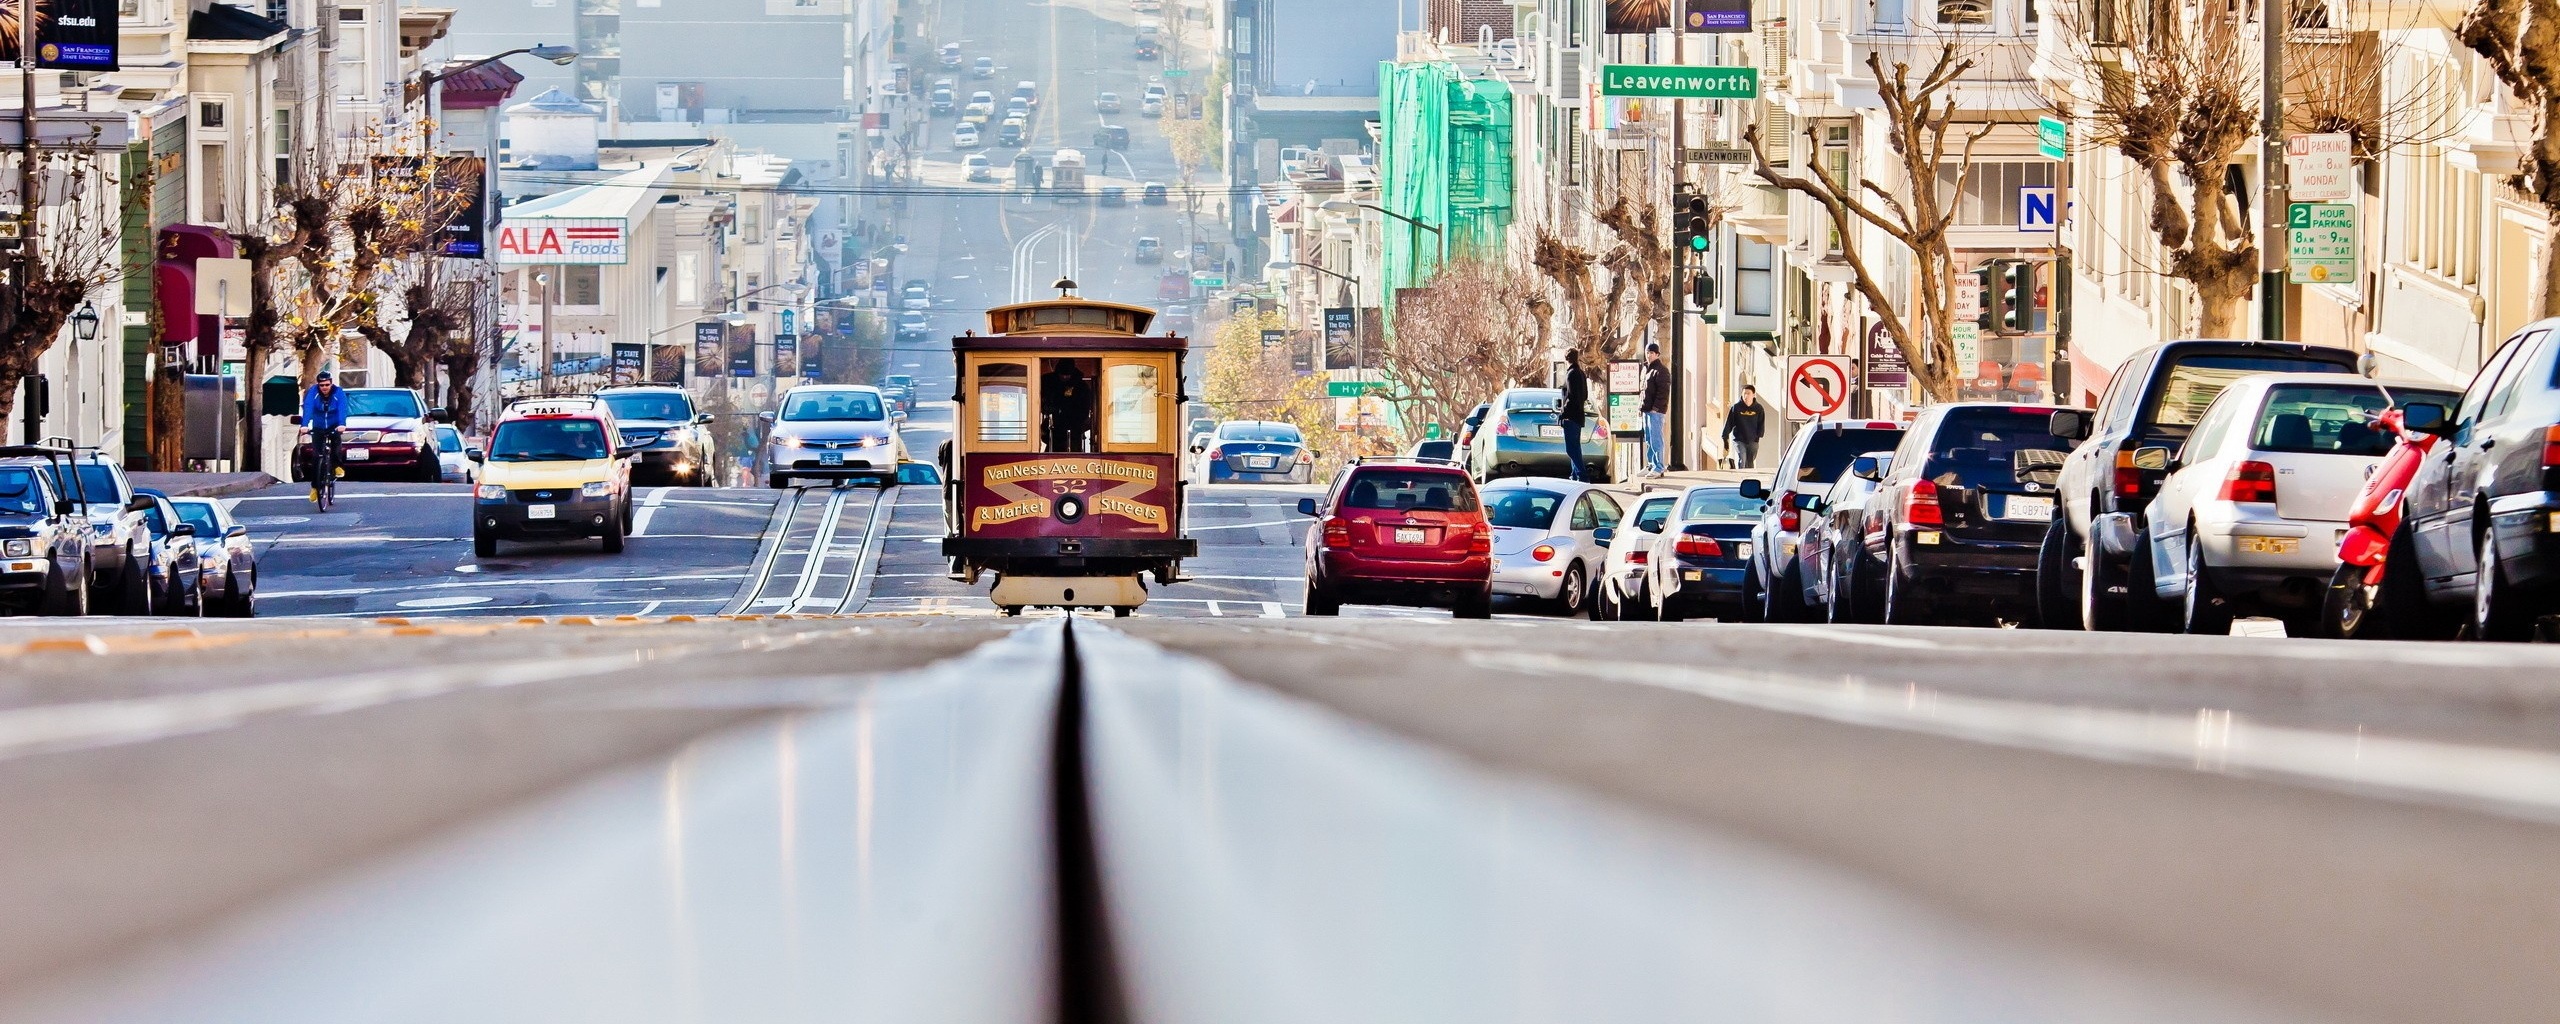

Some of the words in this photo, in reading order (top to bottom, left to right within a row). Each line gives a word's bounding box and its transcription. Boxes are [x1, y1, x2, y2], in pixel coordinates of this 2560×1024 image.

[58, 14, 96, 27] sfsu.edu
[1609, 72, 1750, 91] Leavenworth
[2291, 137, 2308, 154] NO
[2311, 140, 2347, 153] PARKING
[1689, 152, 1748, 161] LEAVENWORTH
[2303, 175, 2339, 186] MONDAY
[2294, 207, 2307, 224] 2
[2320, 209, 2346, 218] HOUR
[2312, 219, 2353, 229] PARKING
[571, 240, 619, 255] Foods
[2294, 247, 2315, 255] MON
[2334, 246, 2351, 255] SAT
[1955, 278, 1978, 287] ARKING
[1611, 397, 1618, 406] 2
[987, 468, 1011, 481] Van
[1012, 464, 1046, 478] Ness
[1086, 461, 1155, 480] California
[1052, 480, 1088, 494] 52
[981, 507, 991, 521] &
[993, 501, 1044, 520] Market
[1100, 498, 1158, 519] Streets
